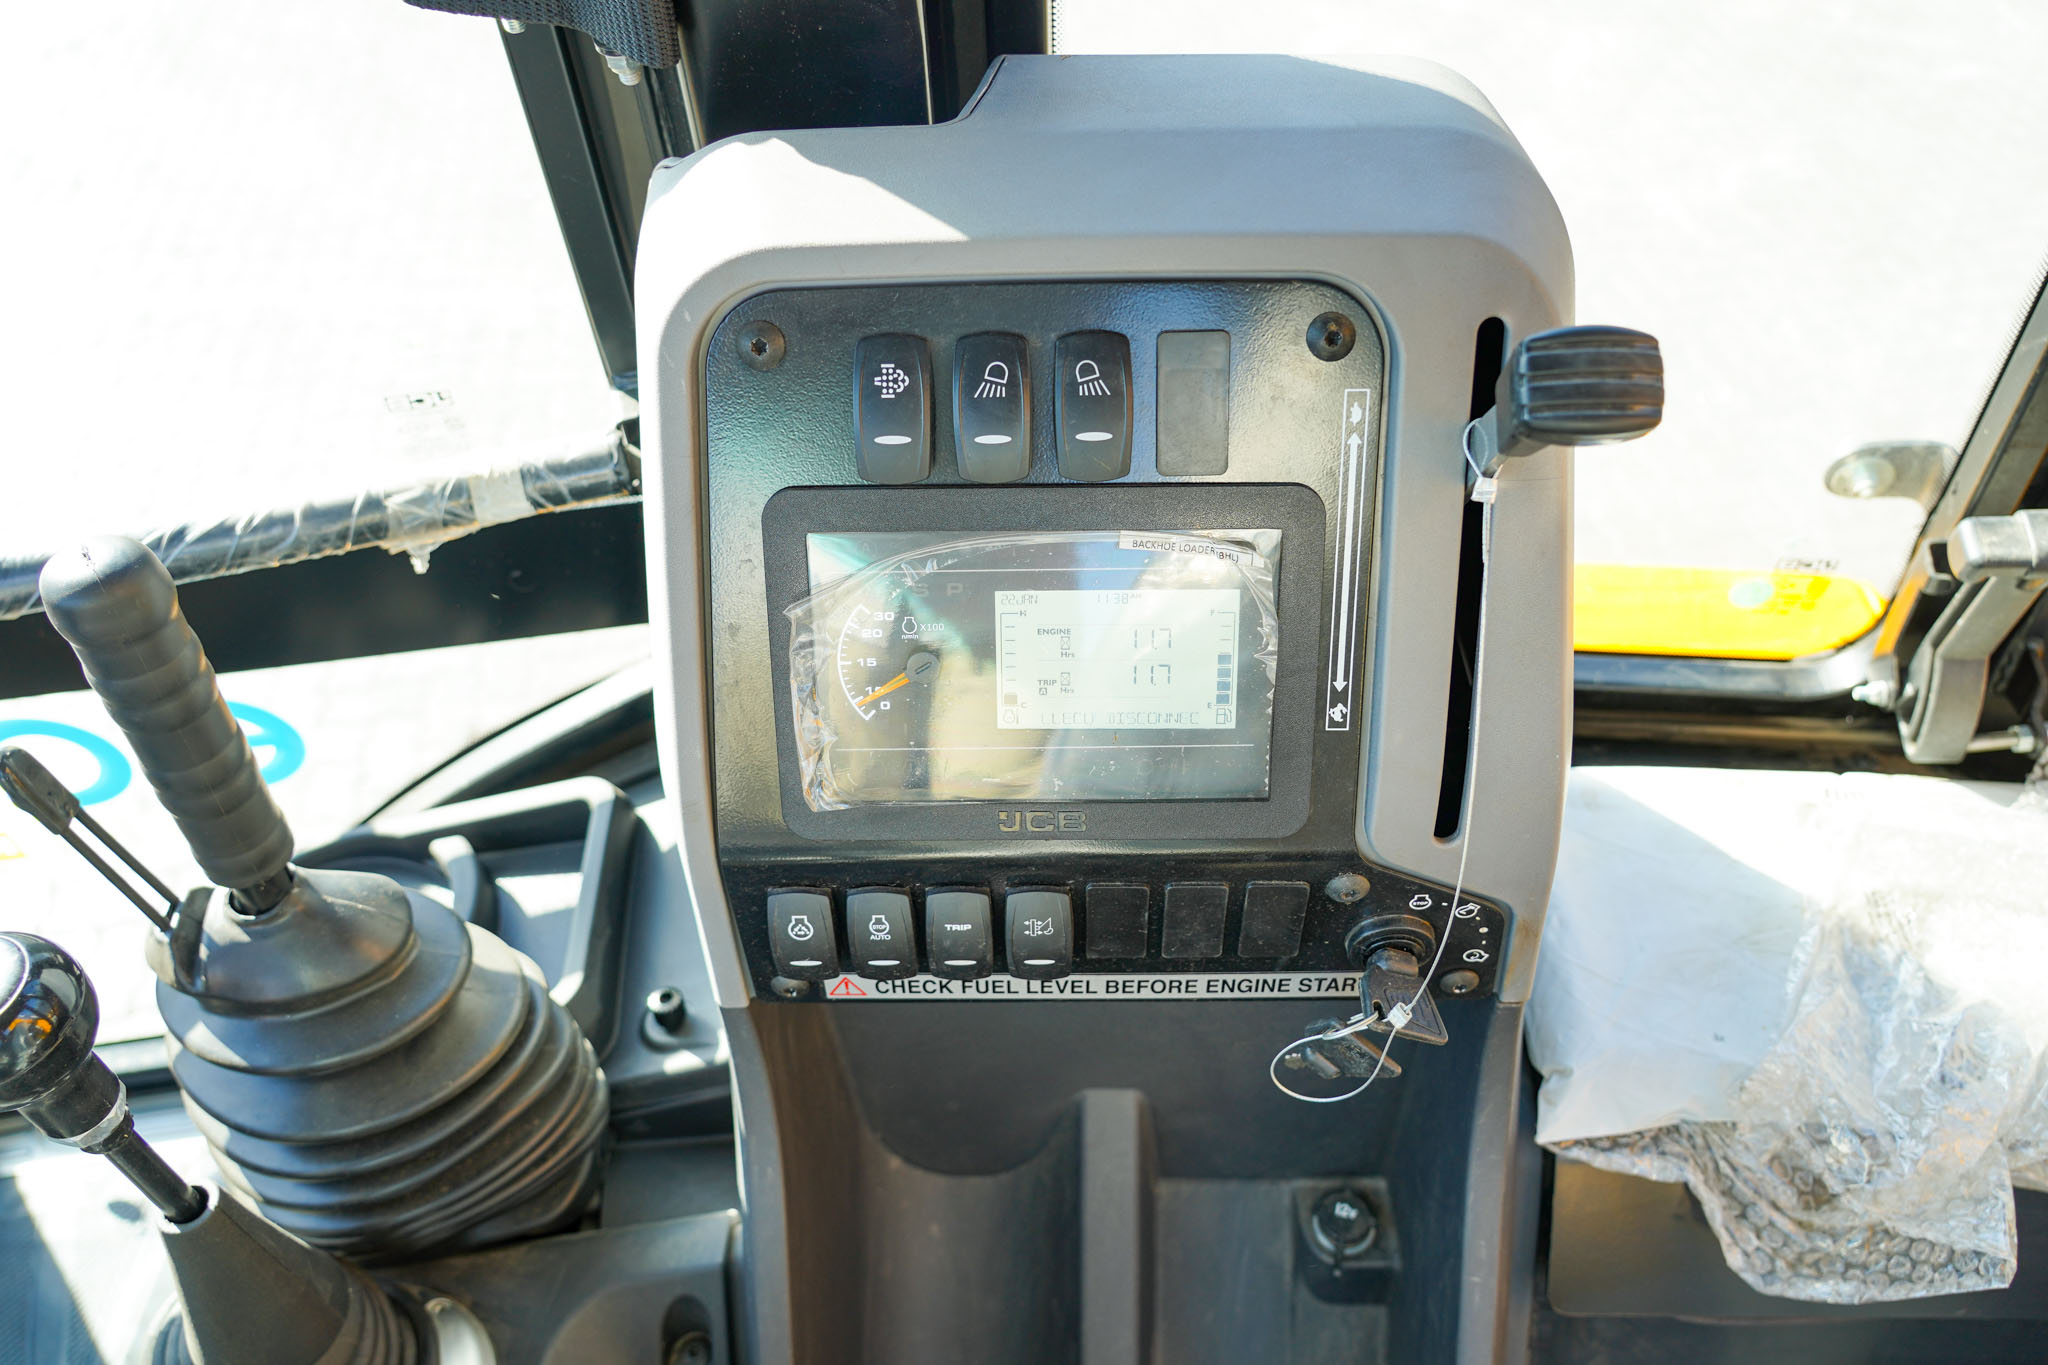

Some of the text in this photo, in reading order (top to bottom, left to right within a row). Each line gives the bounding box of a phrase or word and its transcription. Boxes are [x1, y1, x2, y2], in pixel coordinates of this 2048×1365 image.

[1132, 539, 1176, 552] BACKHOE
[1179, 543, 1215, 555] LOADER
[873, 611, 895, 622] 30
[862, 628, 883, 638] 20
[1037, 628, 1071, 636] ENGINE
[857, 658, 877, 667] 15
[1037, 679, 1057, 687] TRIP
[880, 701, 891, 710] 0
[998, 810, 1087, 832] JCB
[944, 923, 972, 932] TRIP
[874, 977, 1359, 995] CHECK FUEL LEVEL BEFORE ENGINE STAR
